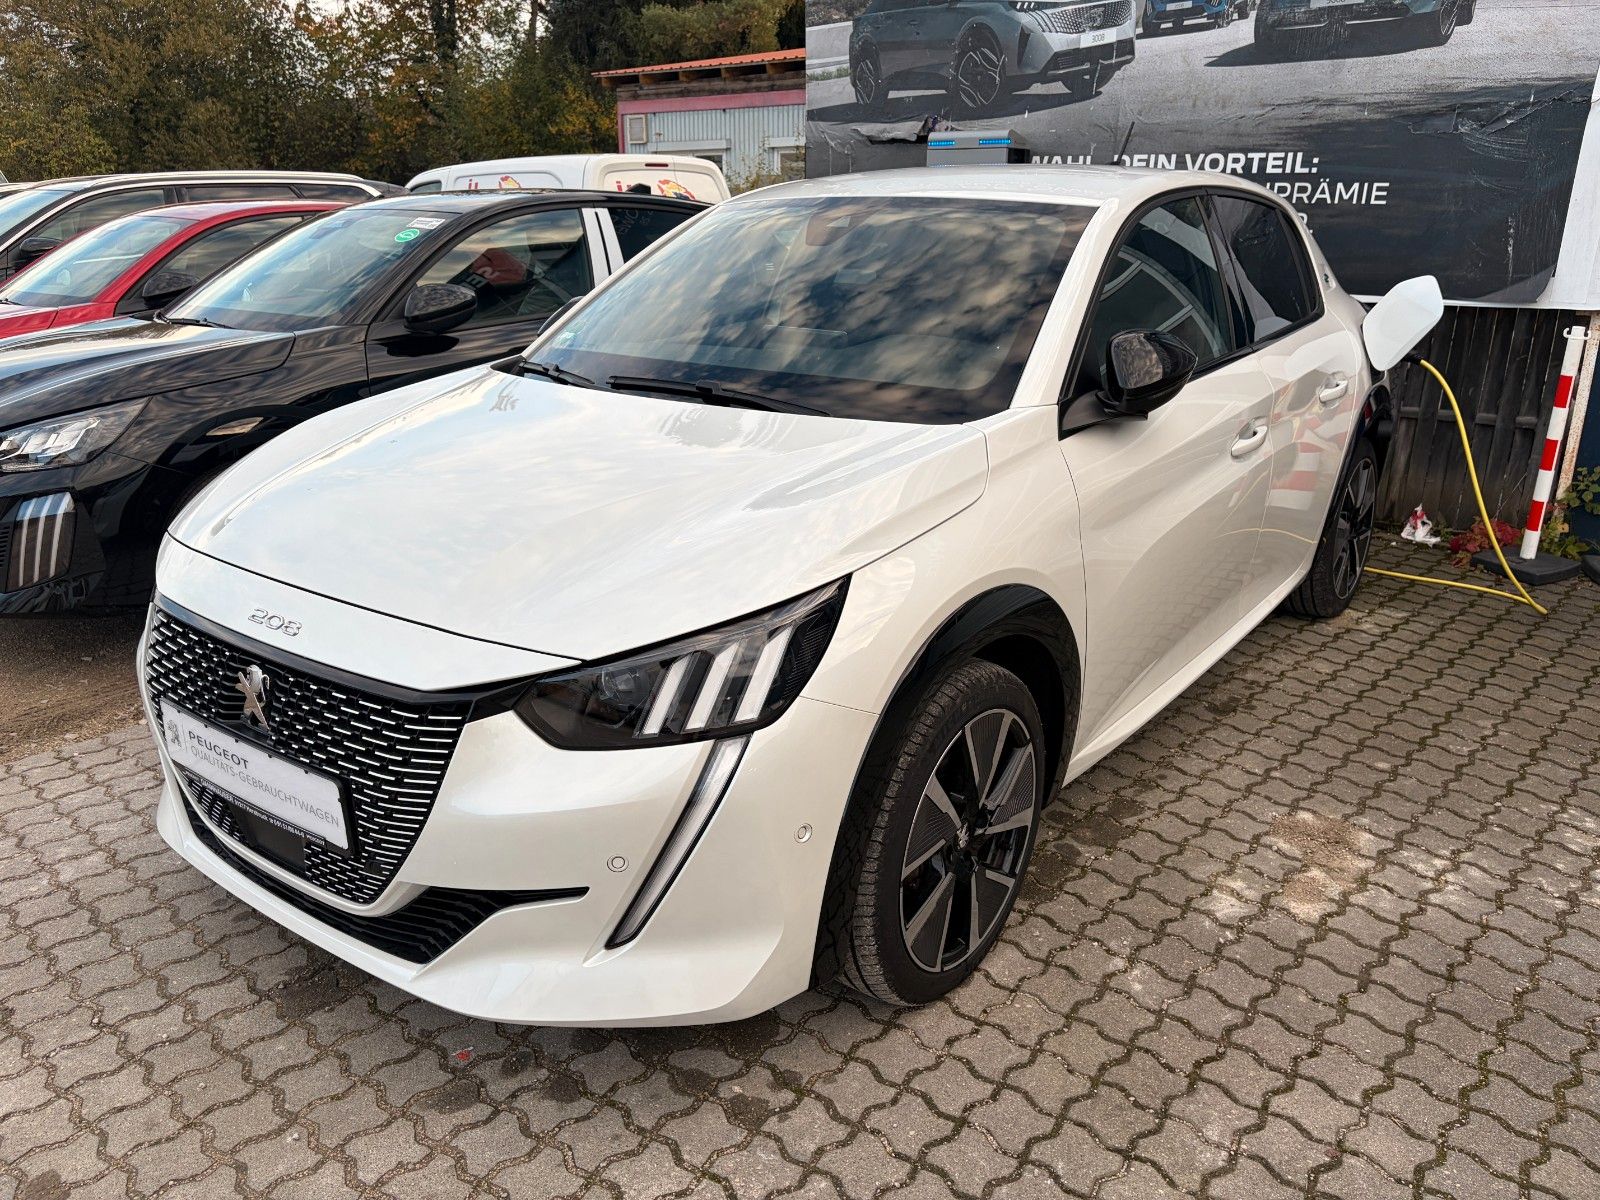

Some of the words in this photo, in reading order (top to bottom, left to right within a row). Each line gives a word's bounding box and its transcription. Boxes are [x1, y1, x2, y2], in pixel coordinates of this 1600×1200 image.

[1184, 152, 1319, 174] VORTEIL:
[1266, 178, 1390, 205] PRÄMIE
[248, 608, 302, 637] 208
[188, 730, 249, 769] PEUGEOT
